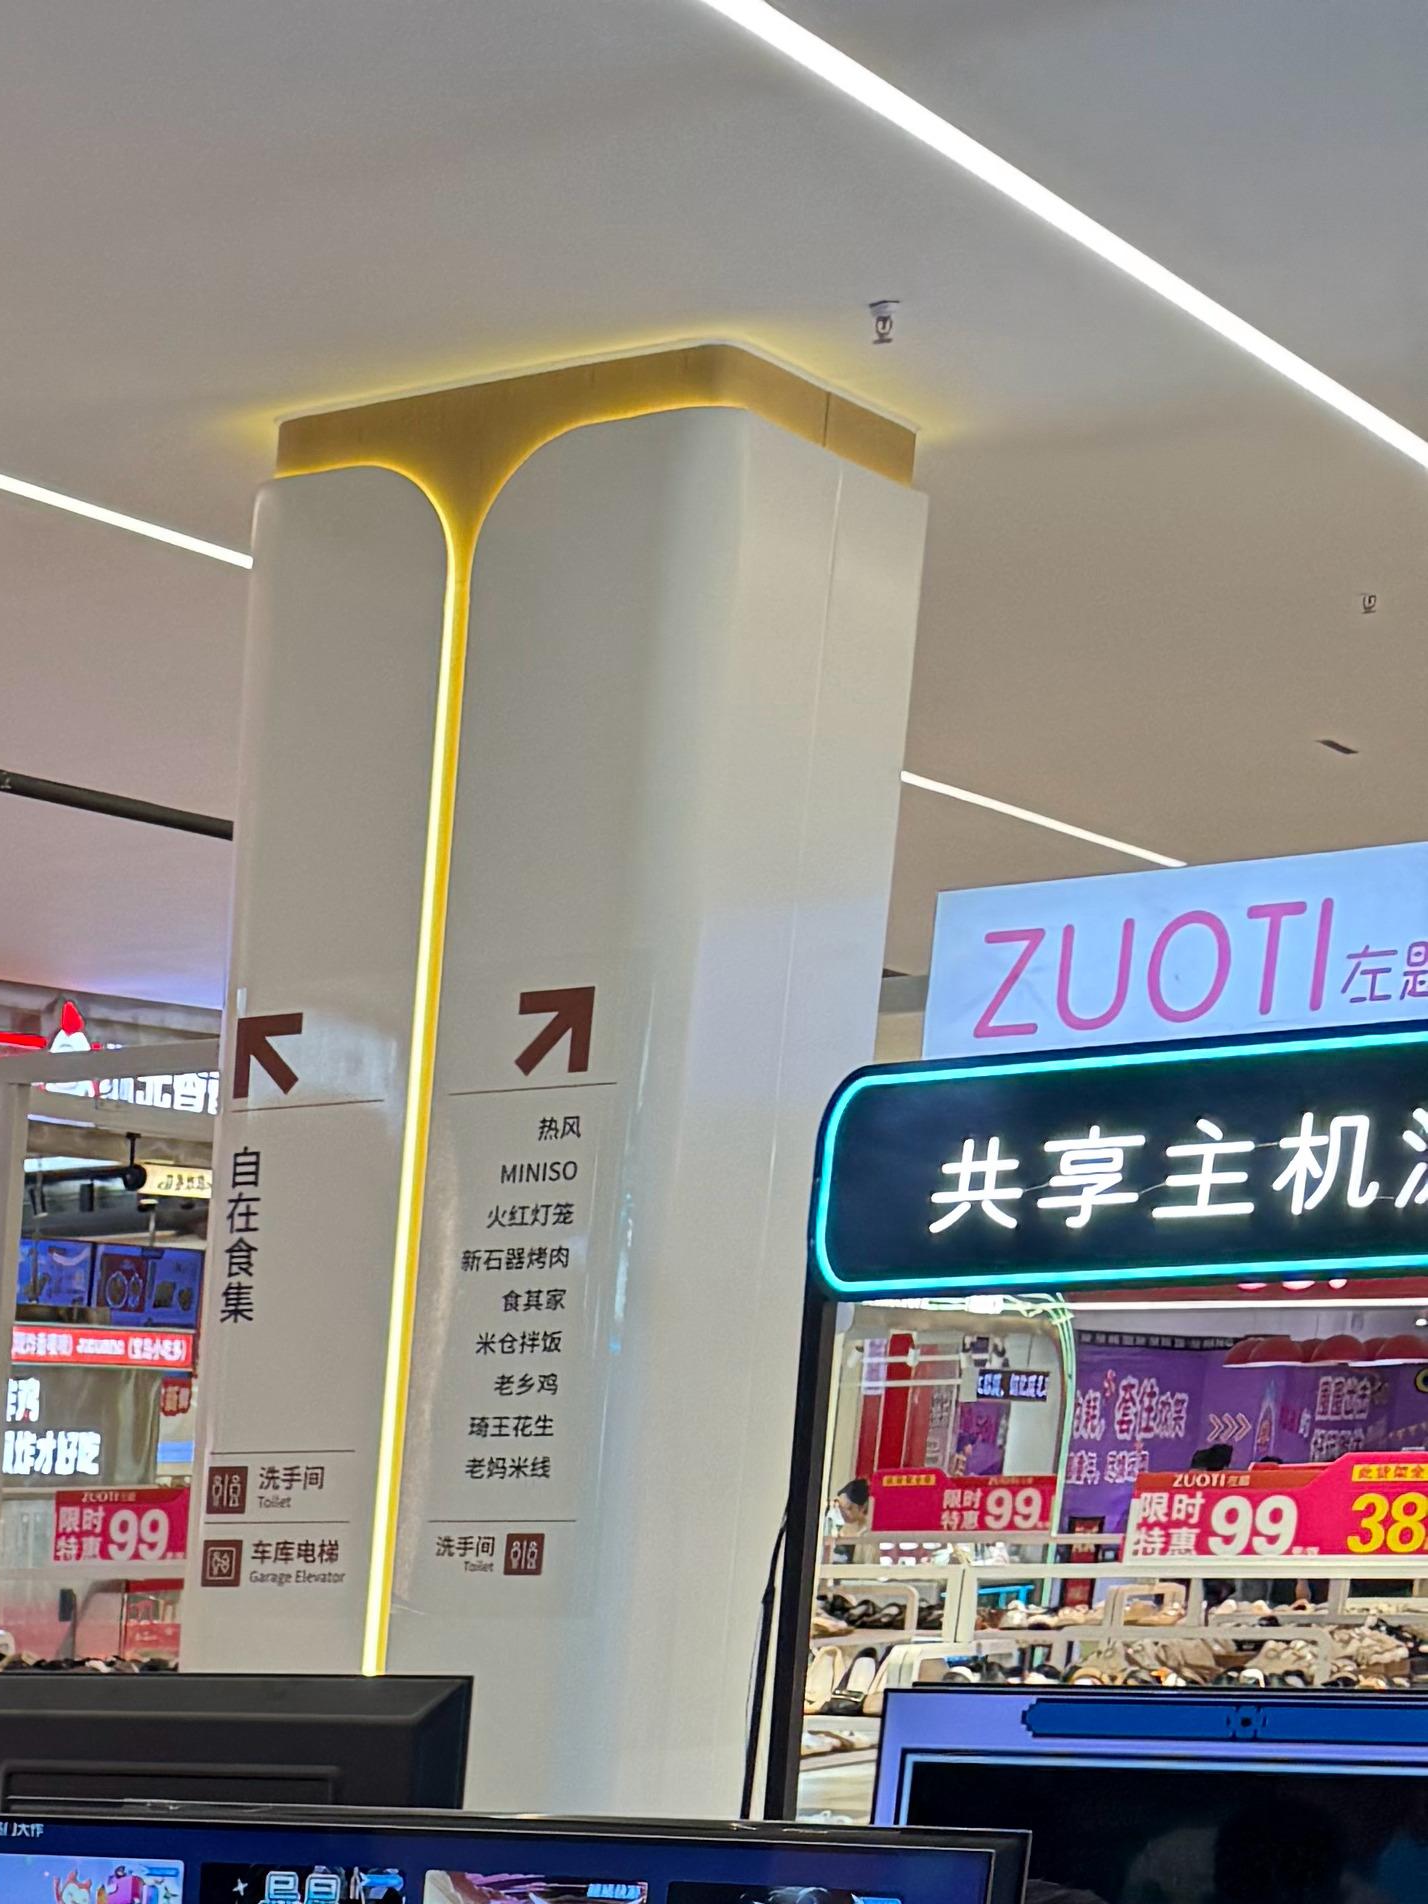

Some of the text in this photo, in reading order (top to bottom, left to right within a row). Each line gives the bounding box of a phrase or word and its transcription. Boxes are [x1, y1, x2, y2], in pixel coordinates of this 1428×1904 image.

[972, 896, 1335, 1040] ZUOTI
[537, 1115, 582, 1141] 热风
[500, 1160, 578, 1185] MINISO
[485, 1201, 575, 1229] 火红灯笼
[219, 1145, 262, 1325] 自在食集
[460, 1244, 570, 1274] 新石器烤肉
[501, 1287, 568, 1313] 食其家
[492, 1371, 560, 1397] 老乡鸡
[257, 1465, 325, 1493] 洗手间
[1172, 1472, 1226, 1488] ZUOTI
[257, 1494, 293, 1510] Toilet
[943, 1488, 981, 1510] 限时
[984, 1487, 1041, 1530] 99
[1137, 1491, 1205, 1523] 限时
[56, 1506, 103, 1533] 限时
[1208, 1494, 1299, 1556] 99
[1346, 1491, 1428, 1554] 38
[108, 1508, 170, 1561] 99
[435, 1535, 496, 1560] 洗手间
[1132, 1525, 1199, 1557] 特惠
[250, 1538, 340, 1566] 车库电梯
[248, 1566, 346, 1587] Garage Elevator
